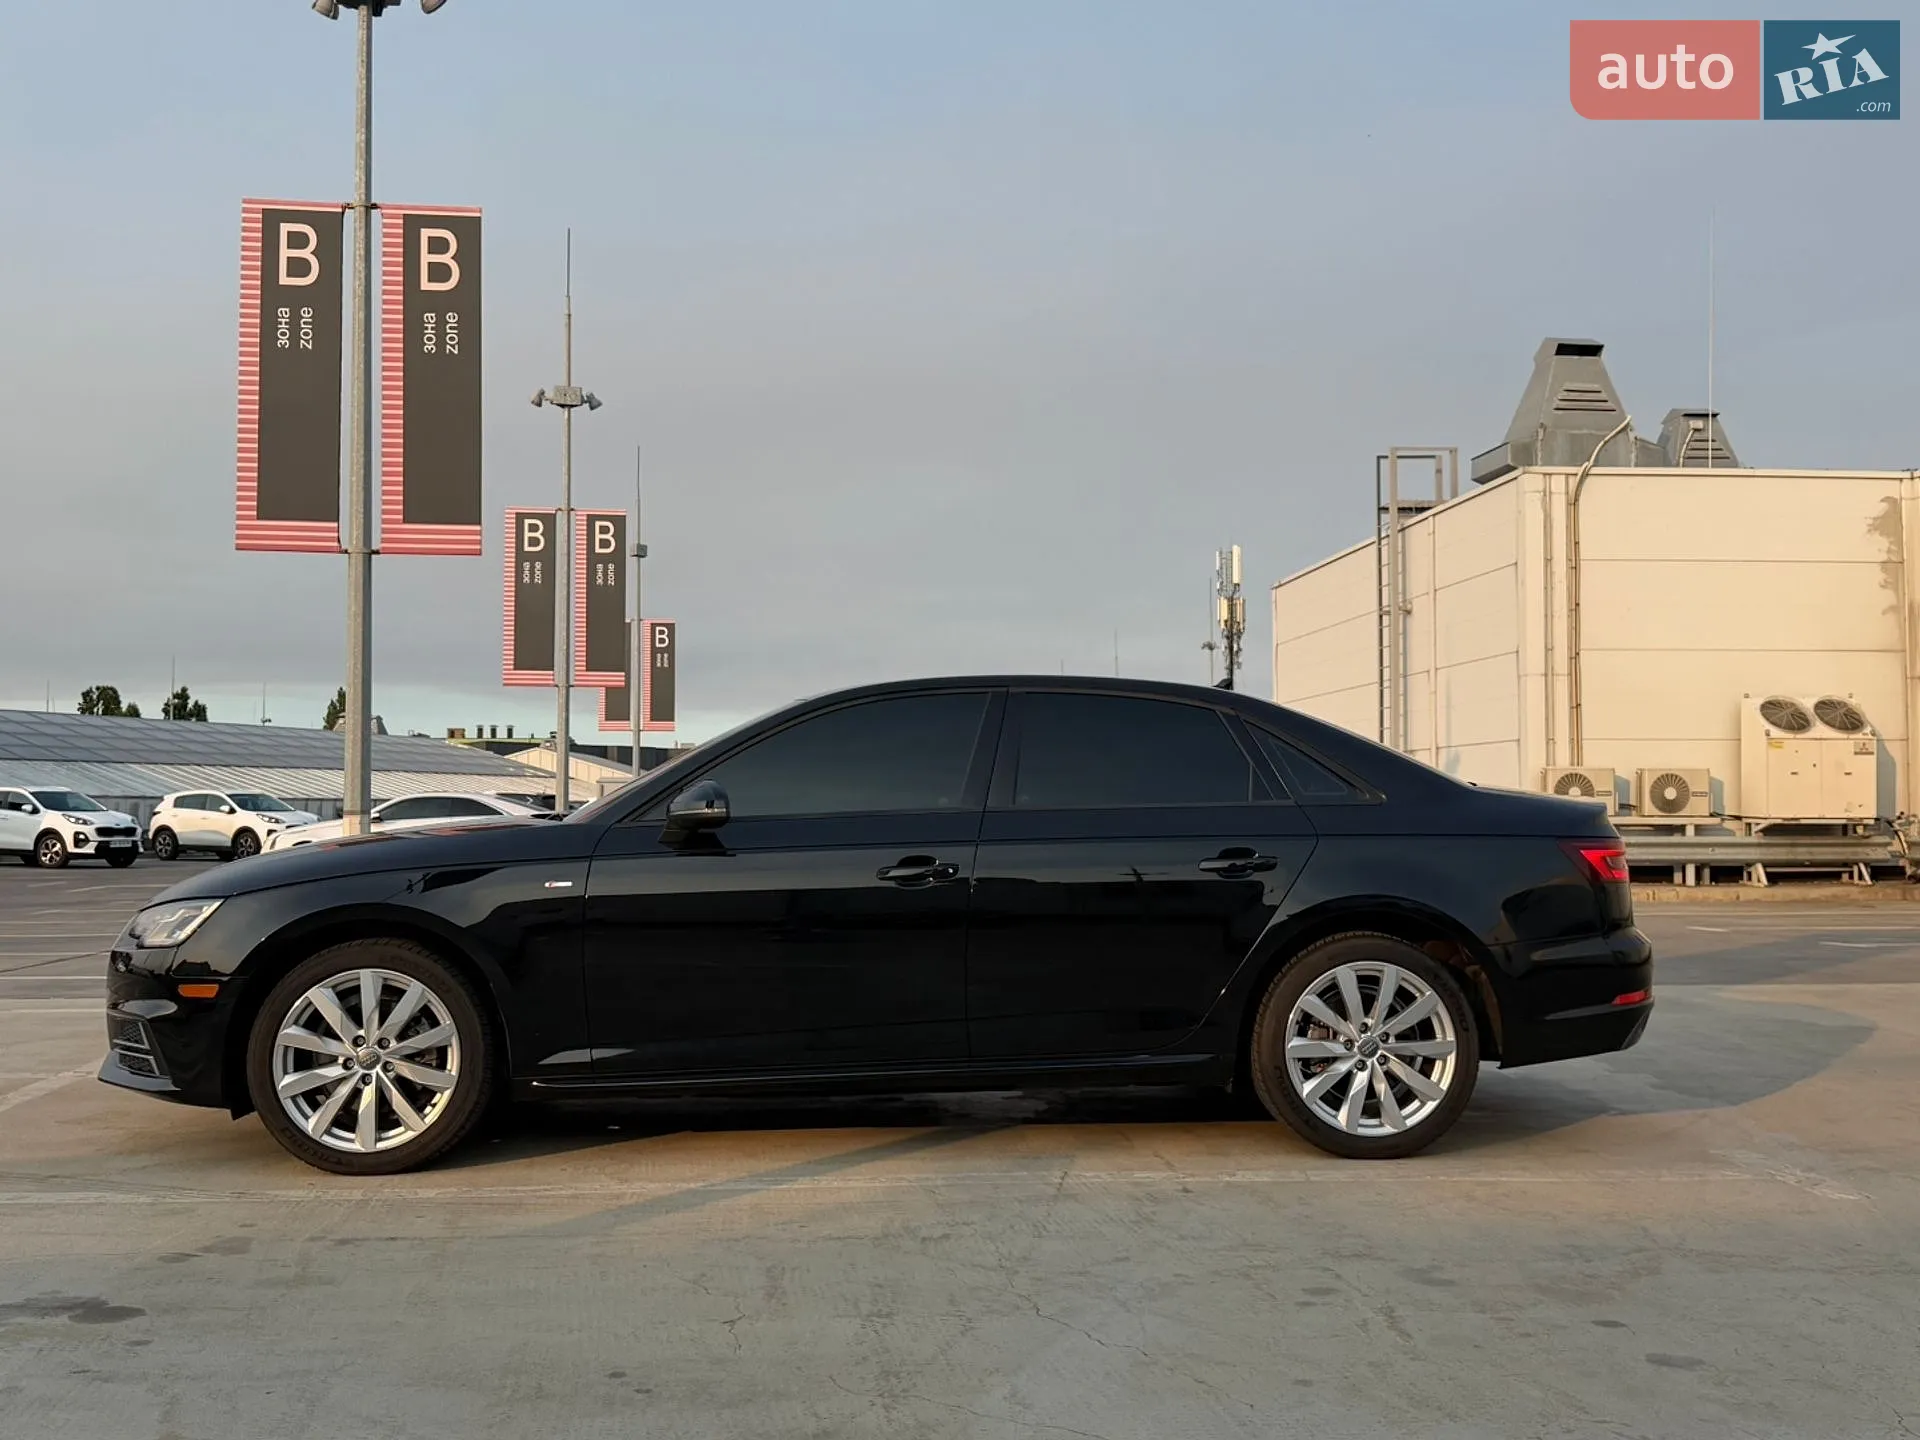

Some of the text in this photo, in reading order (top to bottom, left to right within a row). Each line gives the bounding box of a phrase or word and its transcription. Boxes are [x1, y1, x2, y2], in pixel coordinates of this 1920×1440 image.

[278, 223, 320, 286] B
[420, 228, 461, 291] B
[277, 307, 290, 349] зона
[300, 306, 313, 350] zone
[423, 312, 436, 354] зона
[446, 312, 459, 355] zone
[523, 519, 545, 552] B
[594, 520, 616, 554] B
[655, 626, 669, 648] B
